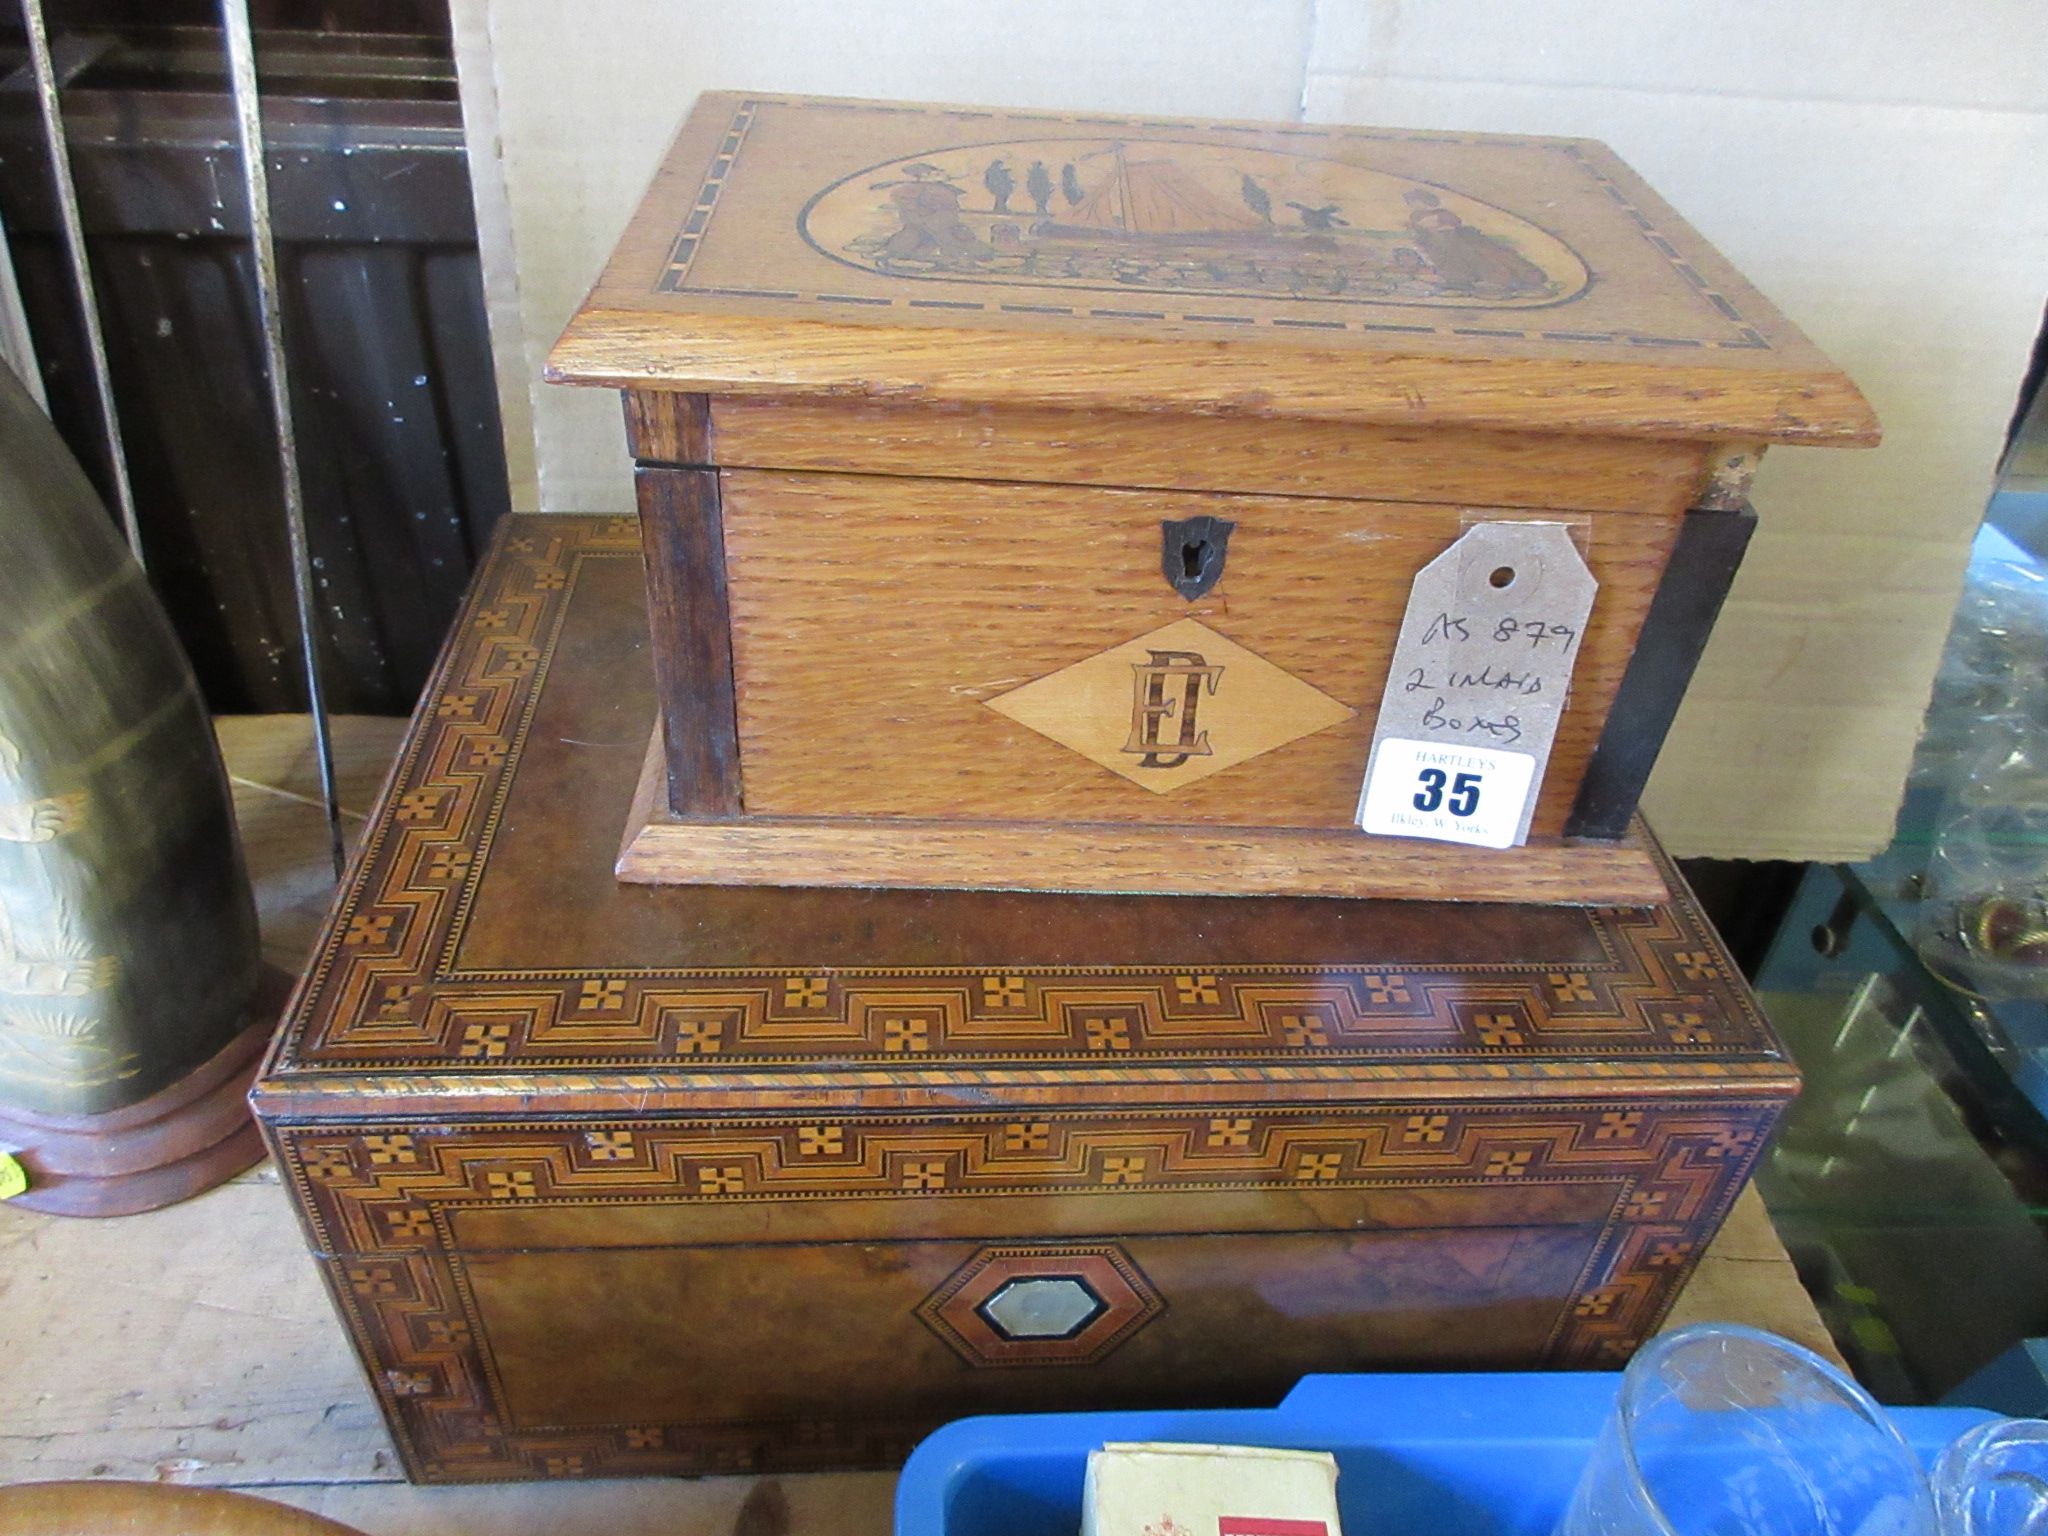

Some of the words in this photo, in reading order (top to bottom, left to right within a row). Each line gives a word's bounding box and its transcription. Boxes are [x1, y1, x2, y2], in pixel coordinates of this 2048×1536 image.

[1493, 617, 1575, 654] 879
[1405, 667, 1436, 692] 2
[1415, 751, 1496, 771] HARTLEYS
[1412, 768, 1483, 817] 35
[1455, 820, 1489, 834] Yorks
